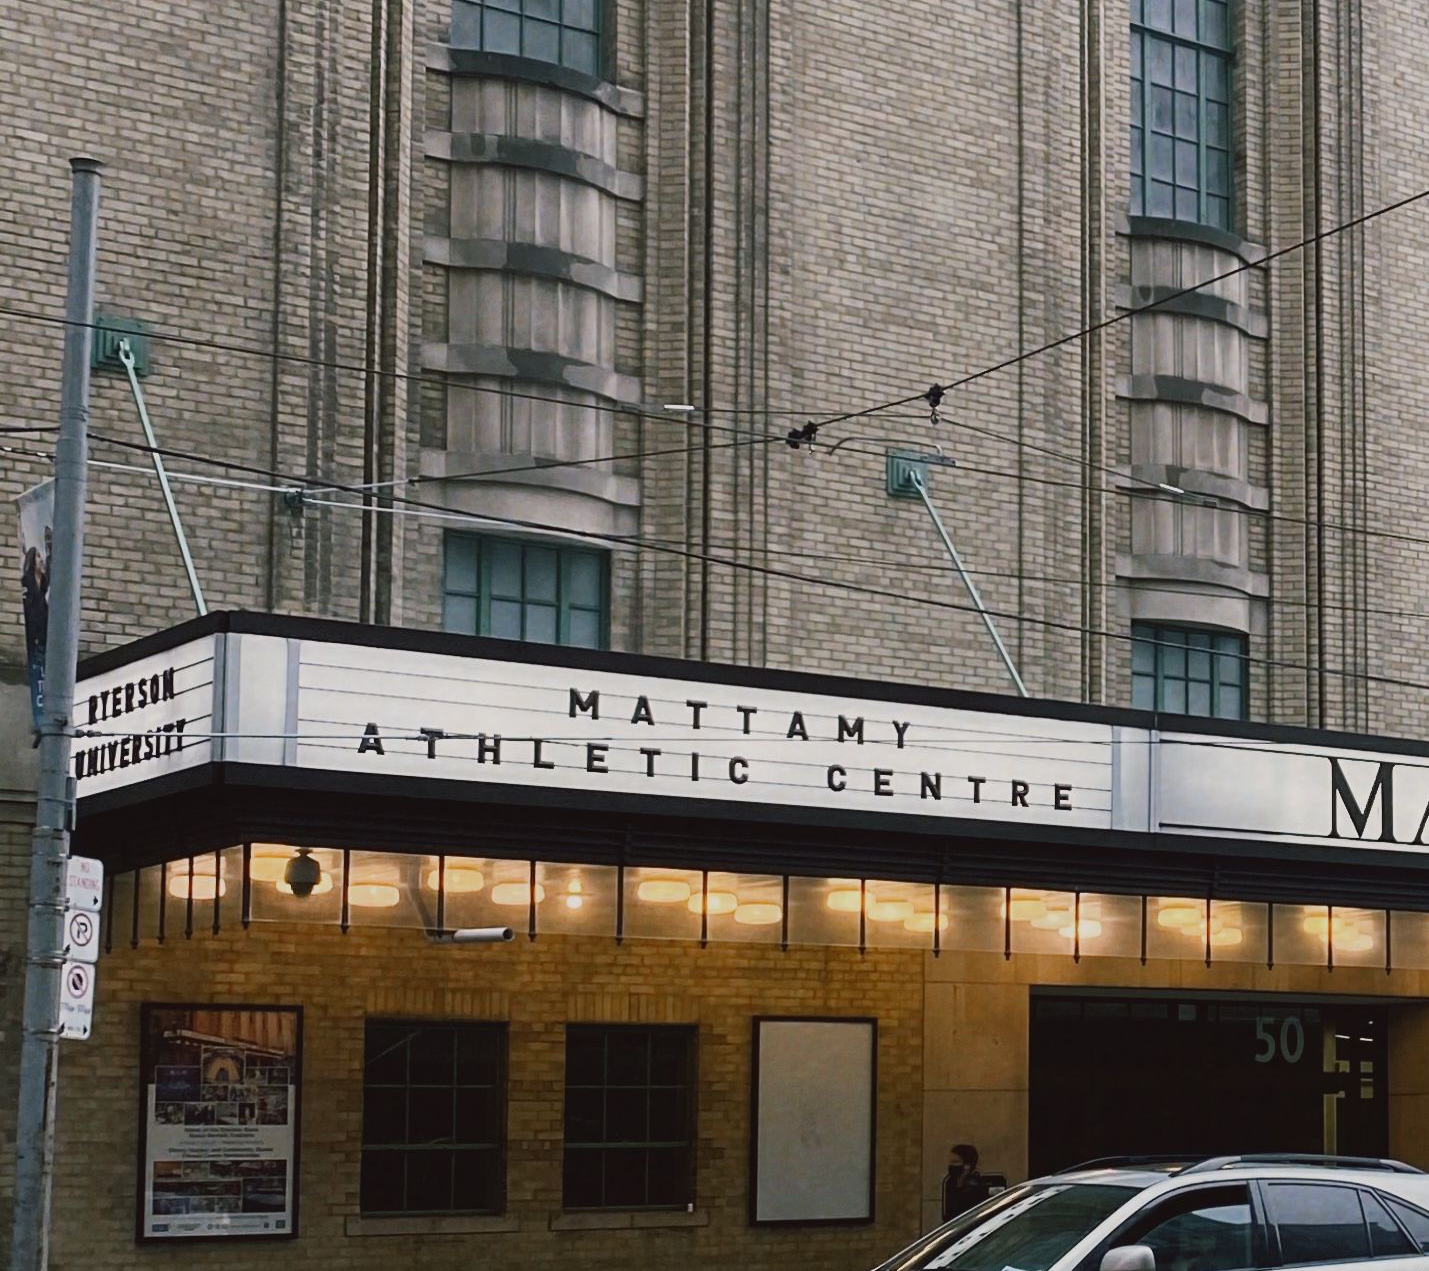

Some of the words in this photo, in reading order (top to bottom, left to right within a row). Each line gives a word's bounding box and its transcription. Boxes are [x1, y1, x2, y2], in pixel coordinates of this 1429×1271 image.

[88, 667, 175, 725] RYERSON
[569, 687, 911, 750] MATTAMY
[75, 718, 186, 780] UNIVERSITY
[357, 722, 750, 785] ATHLETIC
[826, 765, 1073, 812] CENTRE
[1255, 1016, 1304, 1063] 50
